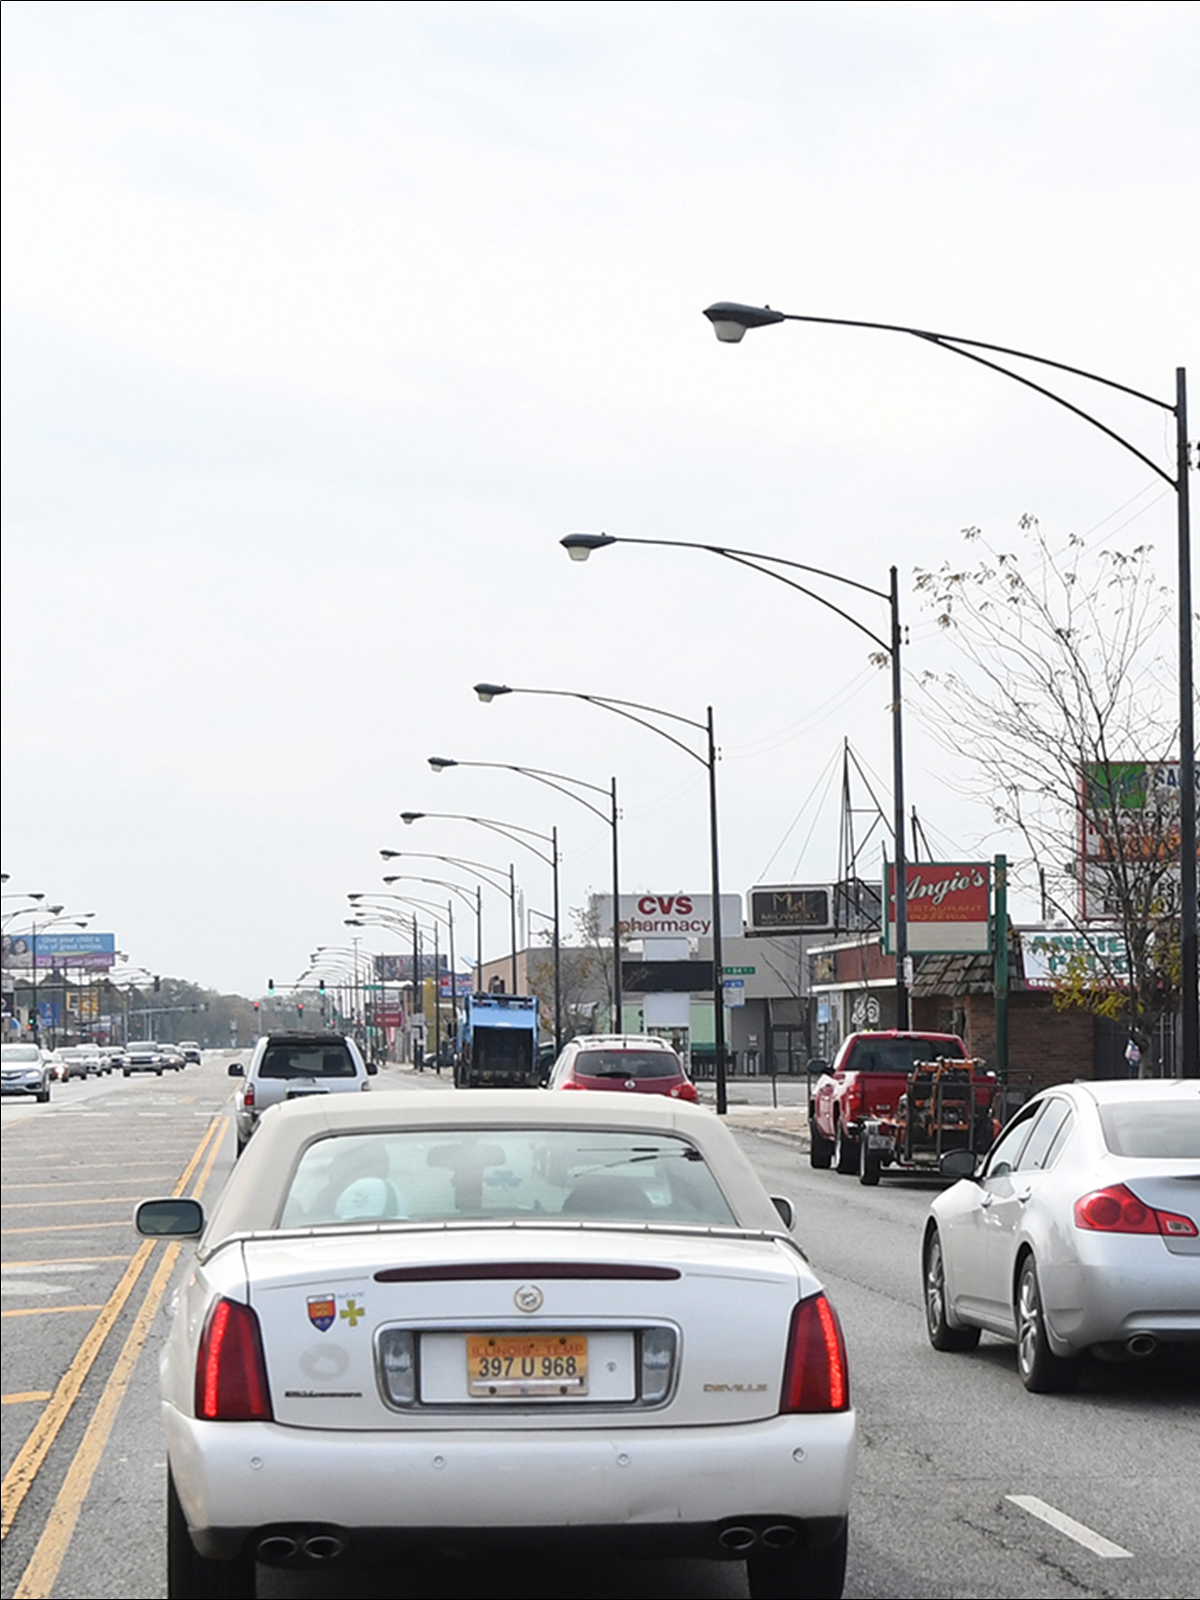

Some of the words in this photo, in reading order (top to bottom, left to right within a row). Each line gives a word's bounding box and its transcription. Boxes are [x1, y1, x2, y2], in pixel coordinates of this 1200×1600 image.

[638, 896, 693, 915] CVS
[472, 1345, 531, 1357] ILLINOIS
[547, 1344, 583, 1355] TEMP
[479, 1357, 514, 1377] 397
[521, 1356, 535, 1376] U
[542, 1356, 577, 1376] 968
